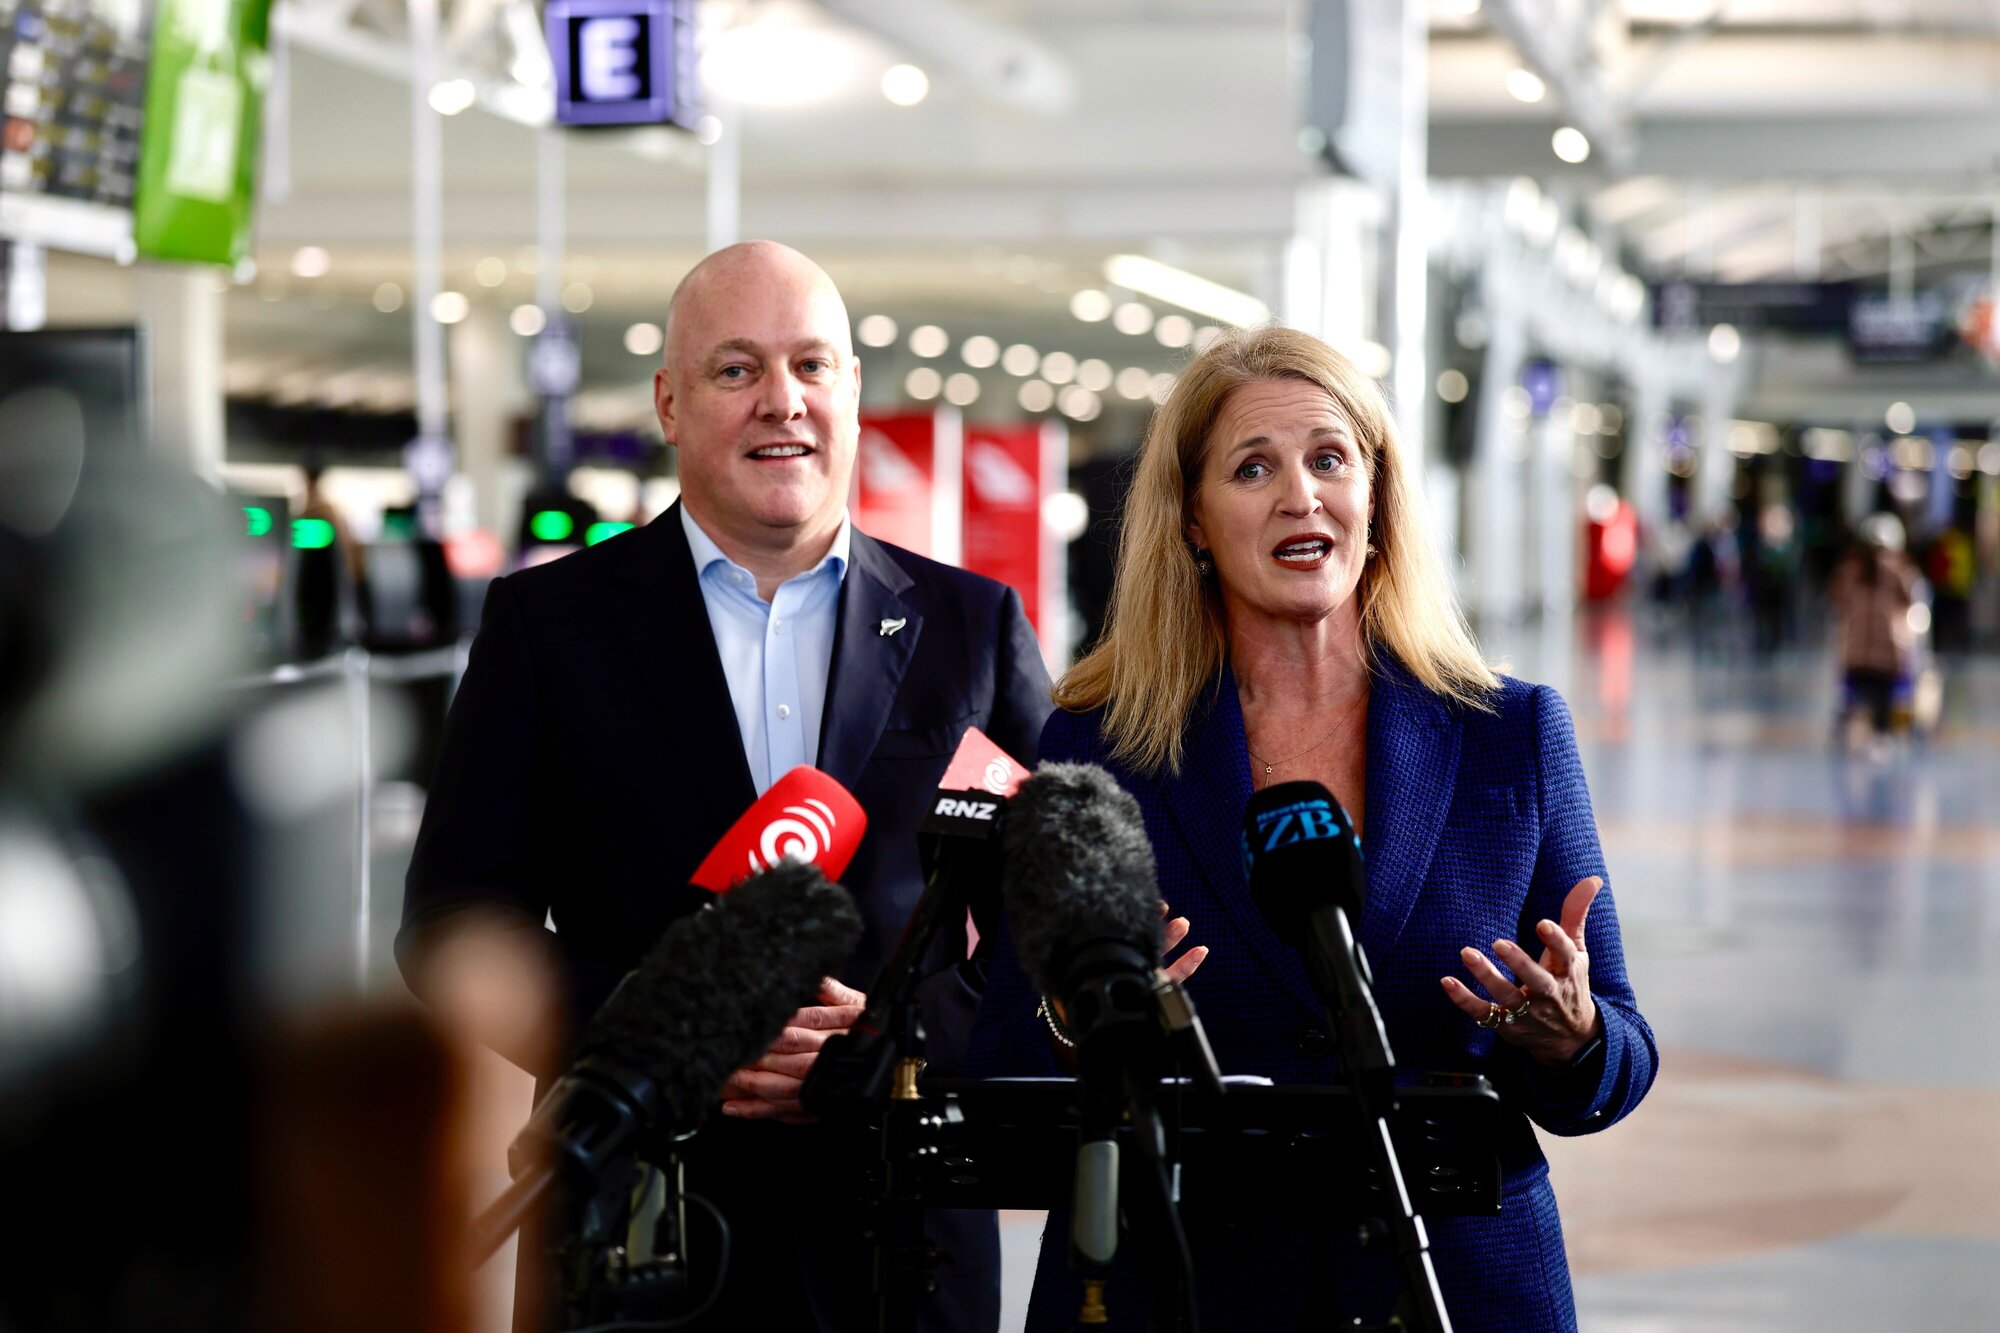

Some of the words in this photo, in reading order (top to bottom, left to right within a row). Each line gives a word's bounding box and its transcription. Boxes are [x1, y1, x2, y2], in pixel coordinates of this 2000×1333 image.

[580, 17, 641, 101] E
[935, 798, 997, 820] RNZ
[1258, 809, 1341, 851] ZB
